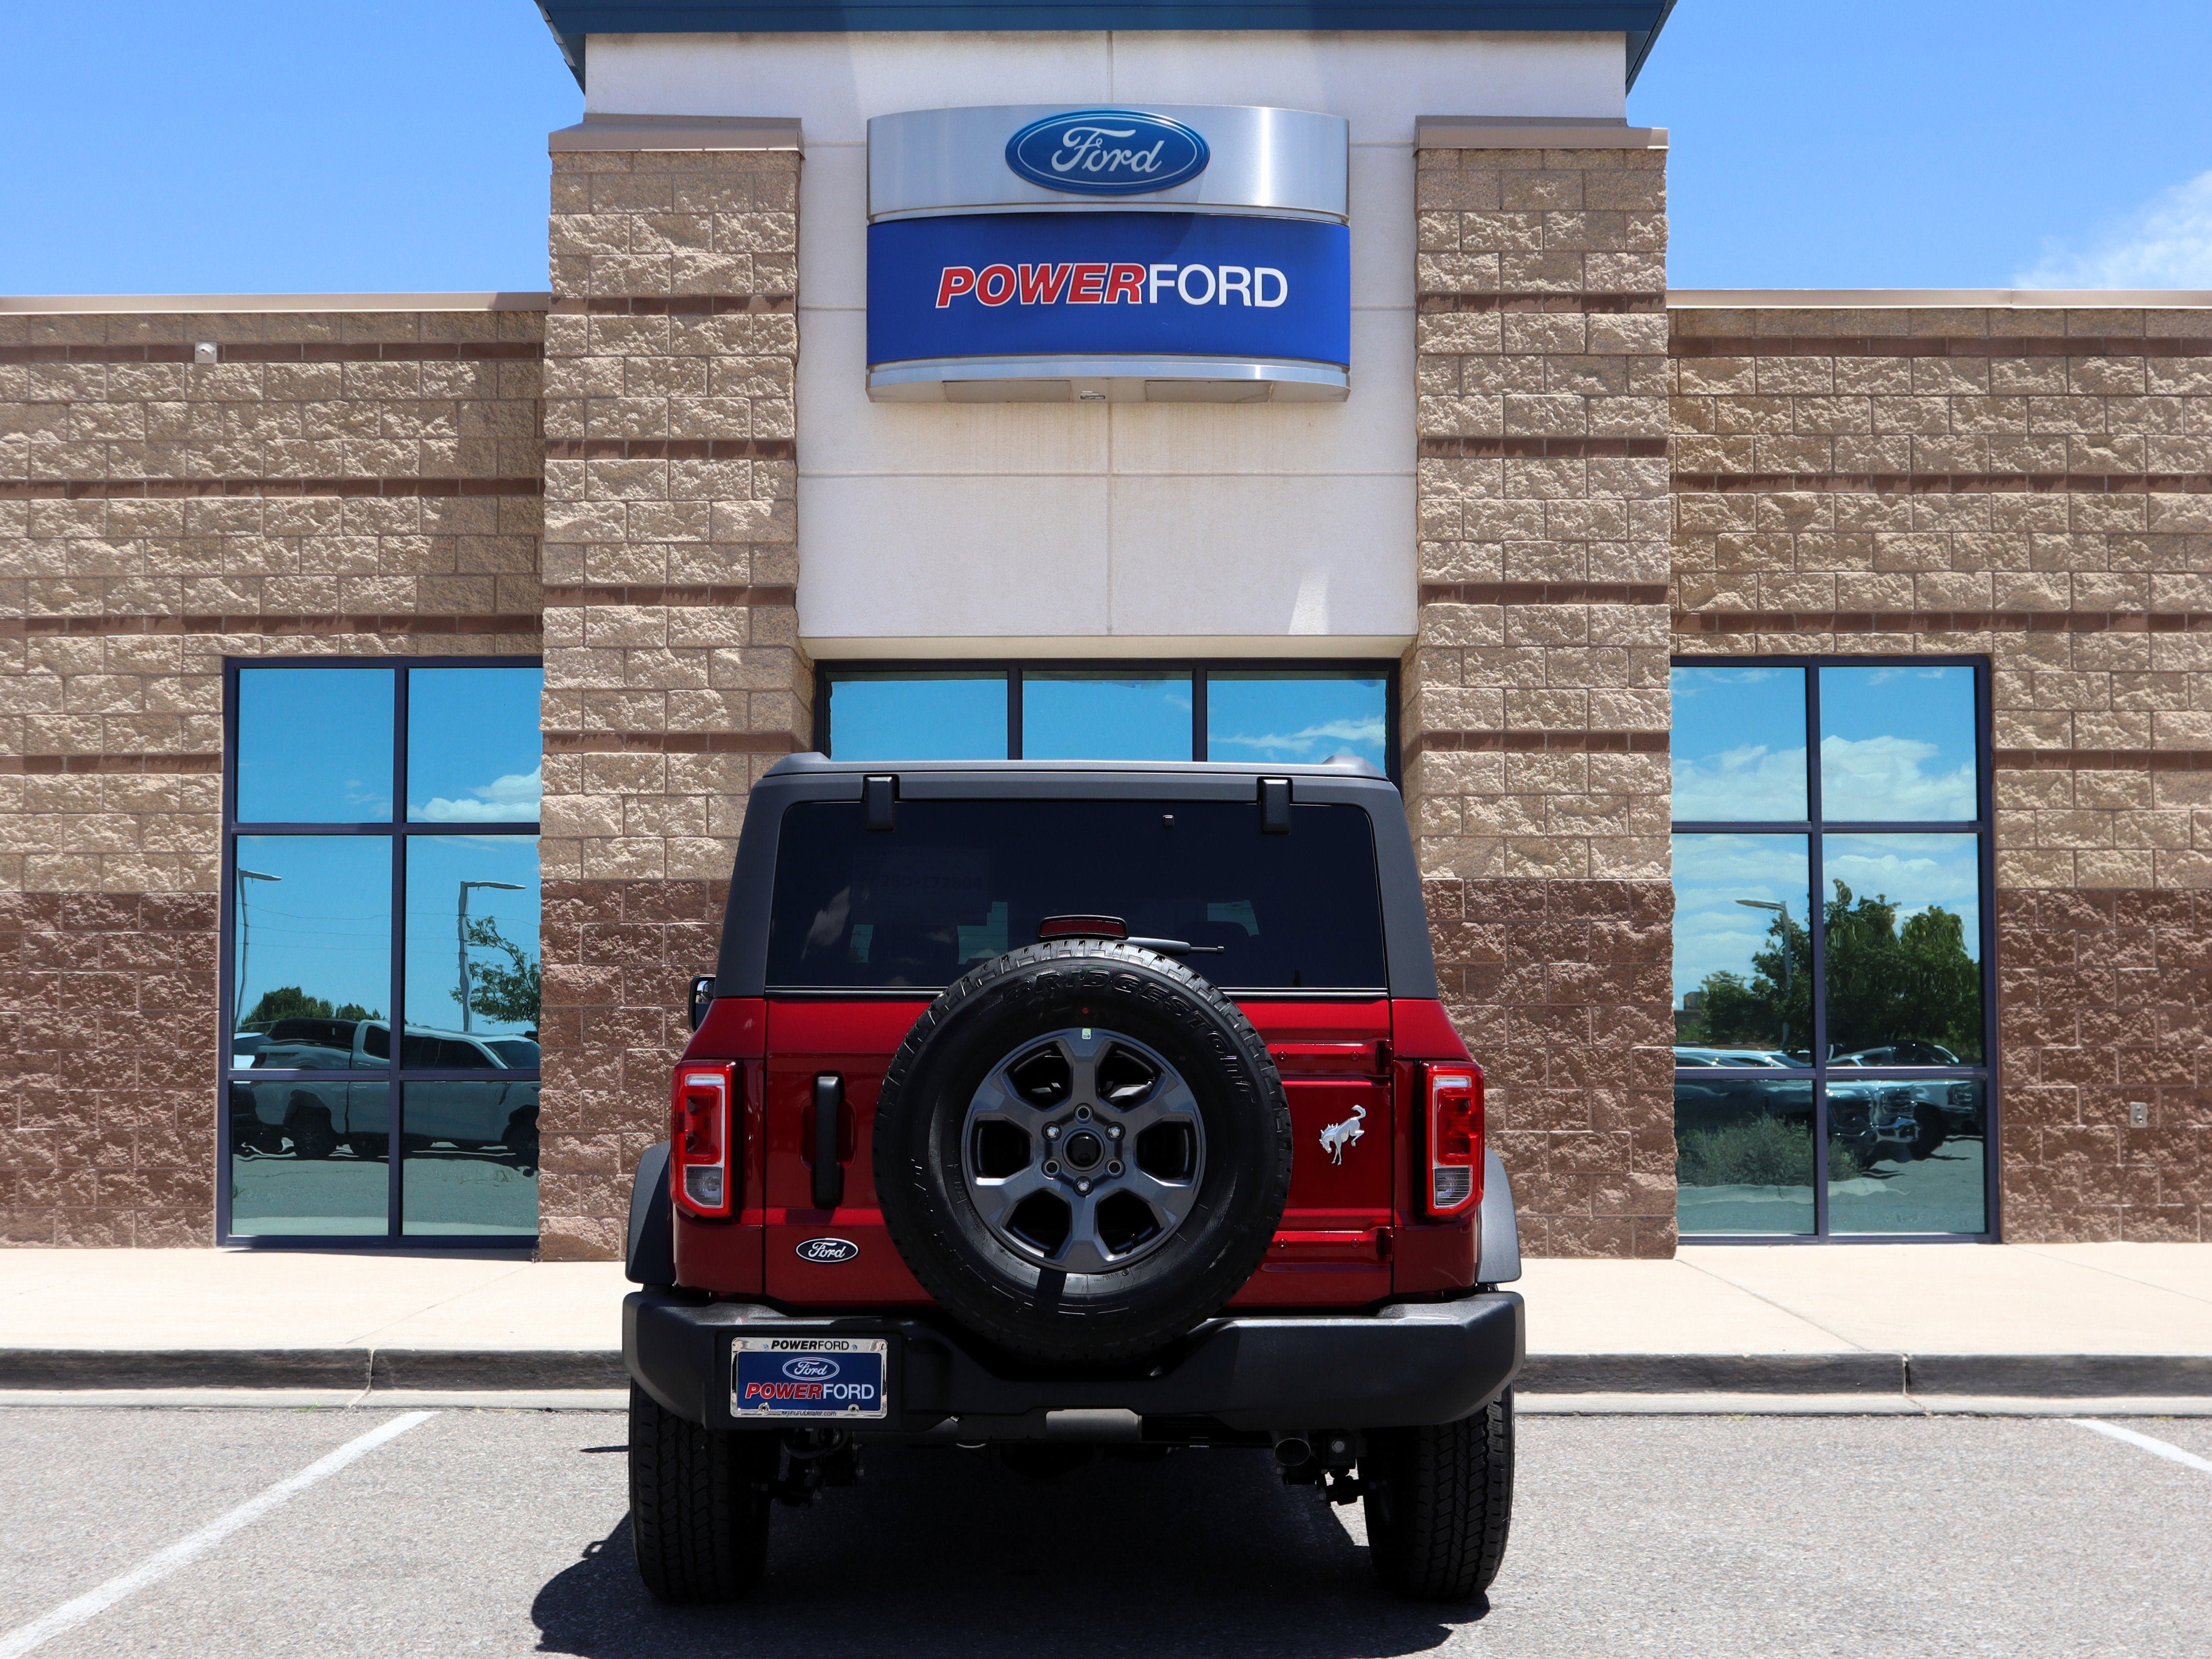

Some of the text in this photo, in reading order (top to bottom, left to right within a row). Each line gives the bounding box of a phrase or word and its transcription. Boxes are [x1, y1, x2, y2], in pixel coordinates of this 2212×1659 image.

[1051, 126, 1164, 173] Ford
[935, 262, 1289, 308] POWERFORD
[808, 1241, 846, 1258] Ford
[771, 1340, 849, 1351] POWERFORD
[794, 1361, 827, 1376] Ford
[745, 1382, 875, 1400] POWERFORD
